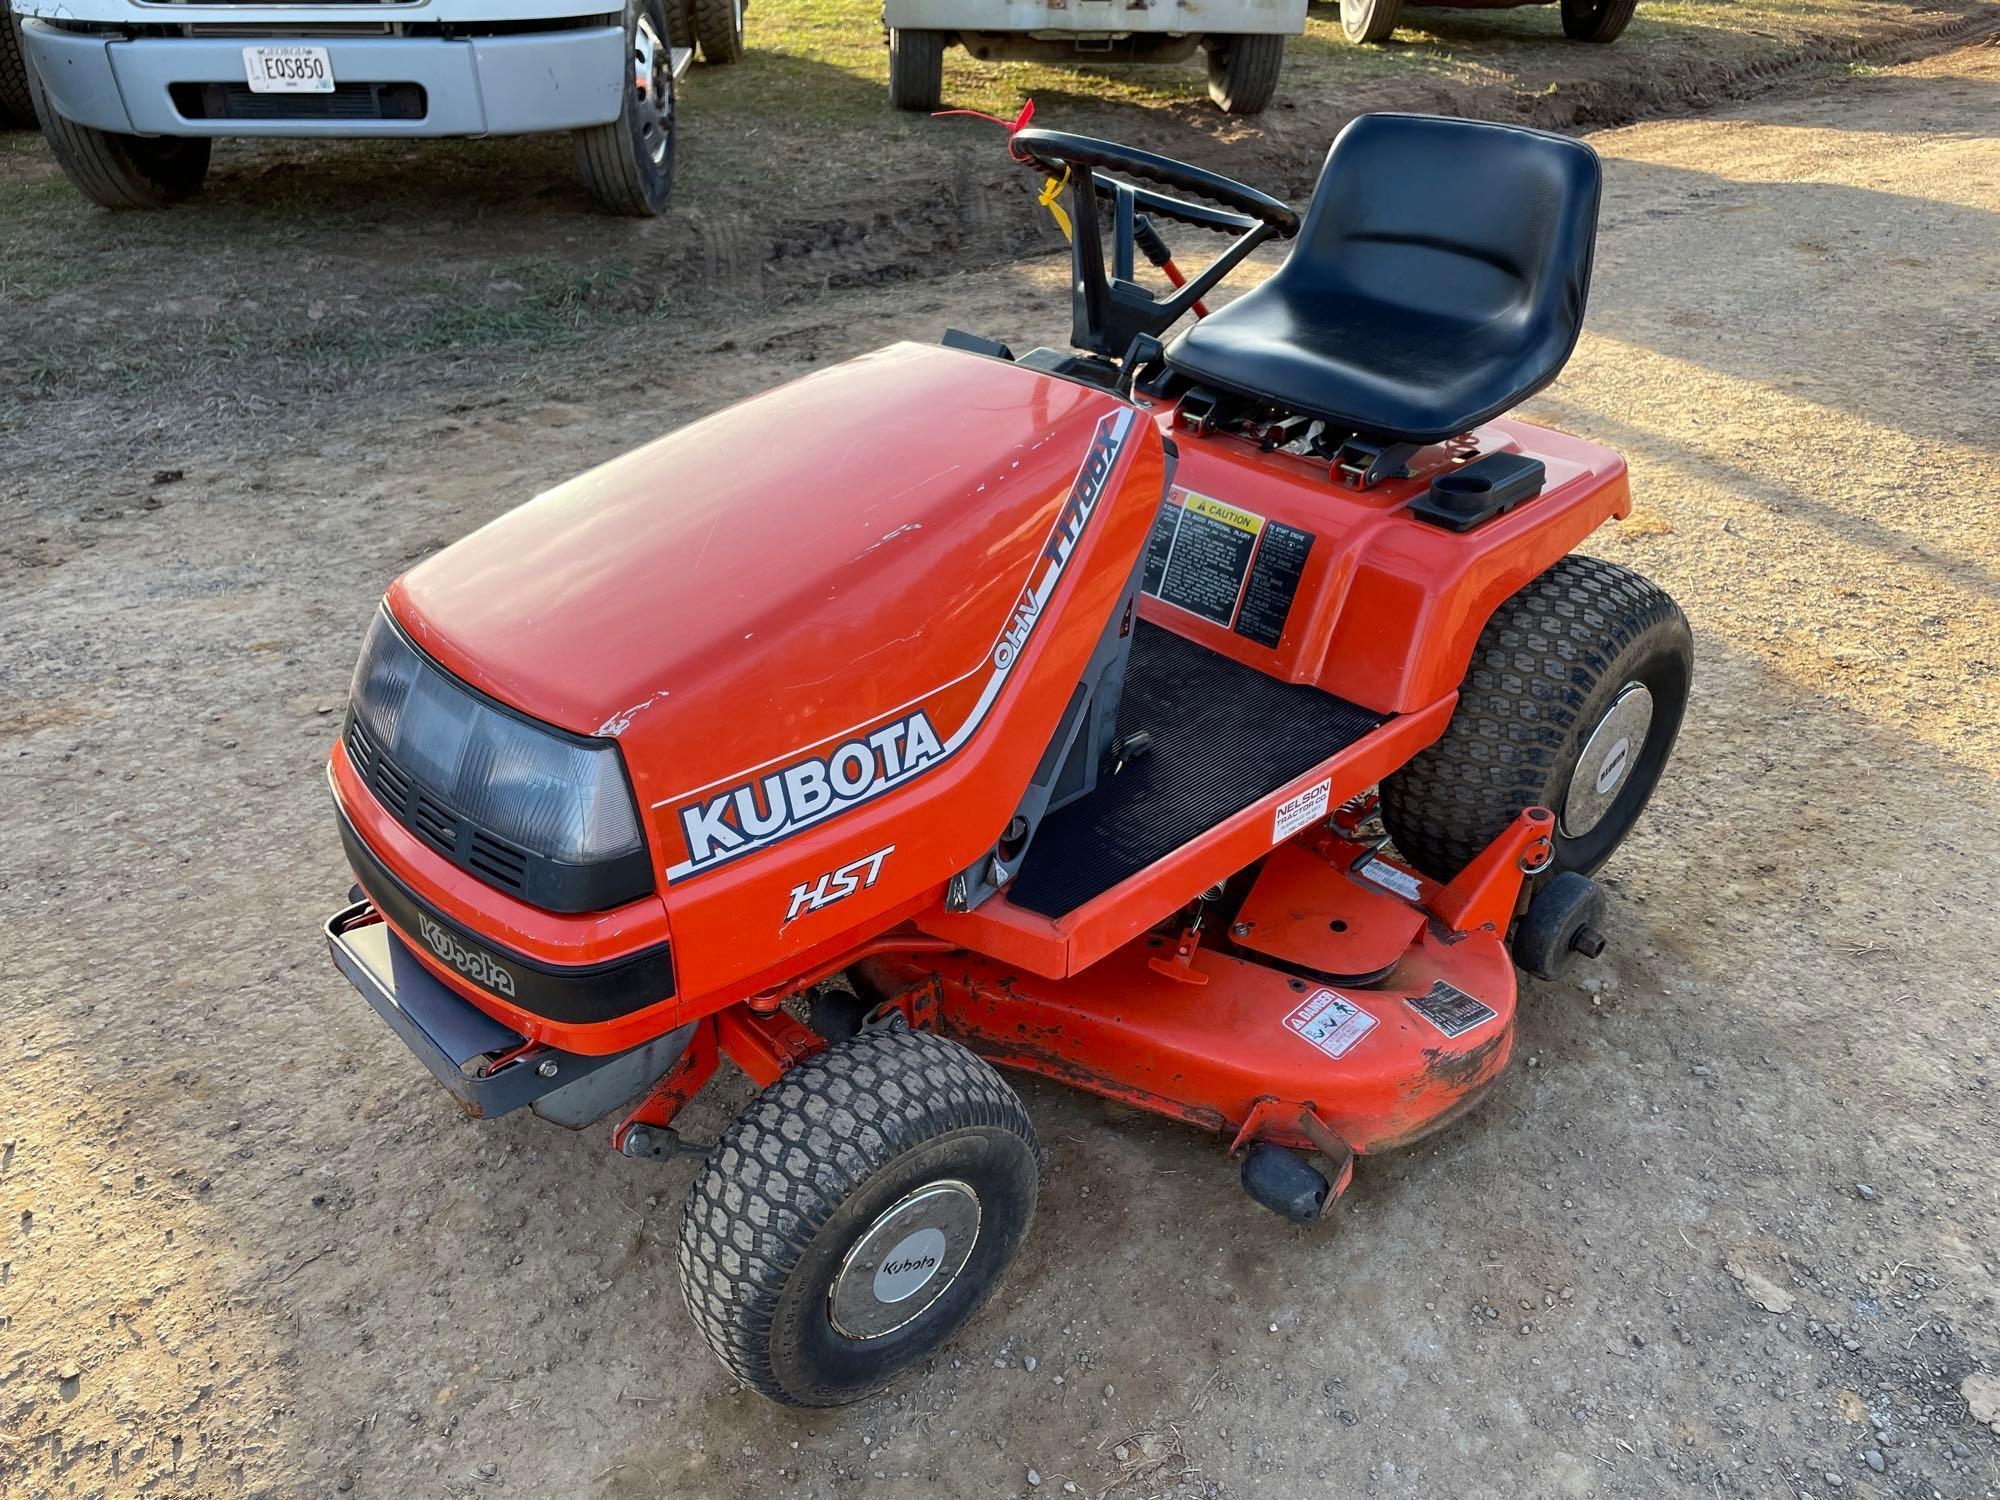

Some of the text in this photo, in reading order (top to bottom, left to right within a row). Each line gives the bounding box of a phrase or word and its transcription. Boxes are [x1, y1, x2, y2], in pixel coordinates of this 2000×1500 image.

[265, 58, 324, 79] EQS850
[1208, 518, 1231, 533] PERSONAL
[1234, 527, 1251, 540] INJURY
[1209, 506, 1251, 527] CAUTION
[1275, 526, 1289, 535] START
[1289, 531, 1305, 540] ENGINE
[994, 587, 1040, 670] OHV
[679, 710, 946, 865] KUBOTA
[1277, 781, 1329, 819] NELSON
[1276, 800, 1314, 826] TRACTOR
[784, 844, 896, 921] HST
[417, 911, 516, 998] Kubota
[883, 1255, 935, 1275] Kubota
